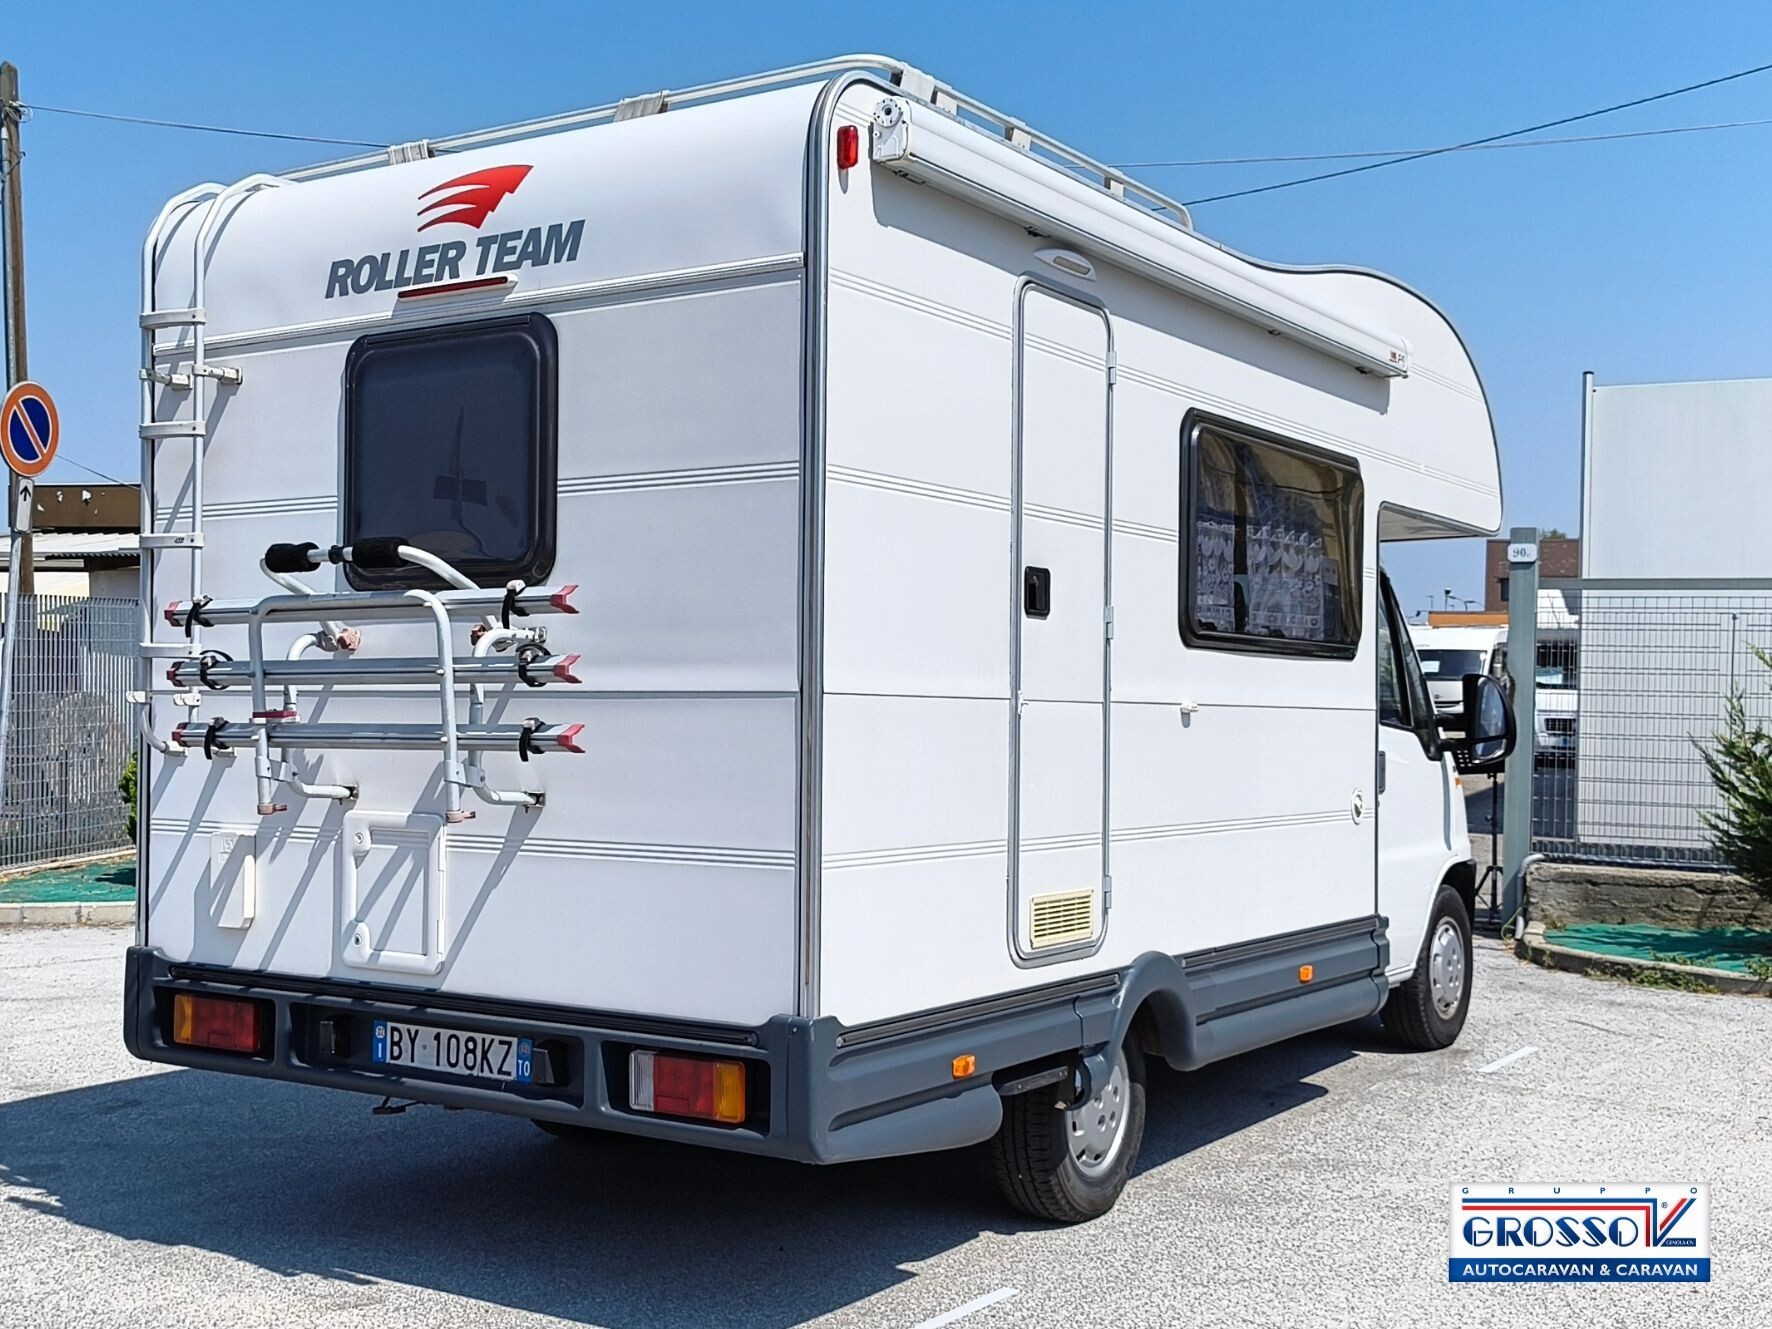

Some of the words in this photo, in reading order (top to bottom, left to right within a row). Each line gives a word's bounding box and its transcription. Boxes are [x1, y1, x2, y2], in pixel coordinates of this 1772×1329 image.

[325, 241, 467, 299] ROLLER
[475, 219, 586, 276] TEAM
[390, 1026, 419, 1063] BY
[433, 1031, 513, 1076] 108KZ
[517, 1060, 531, 1076] TO
